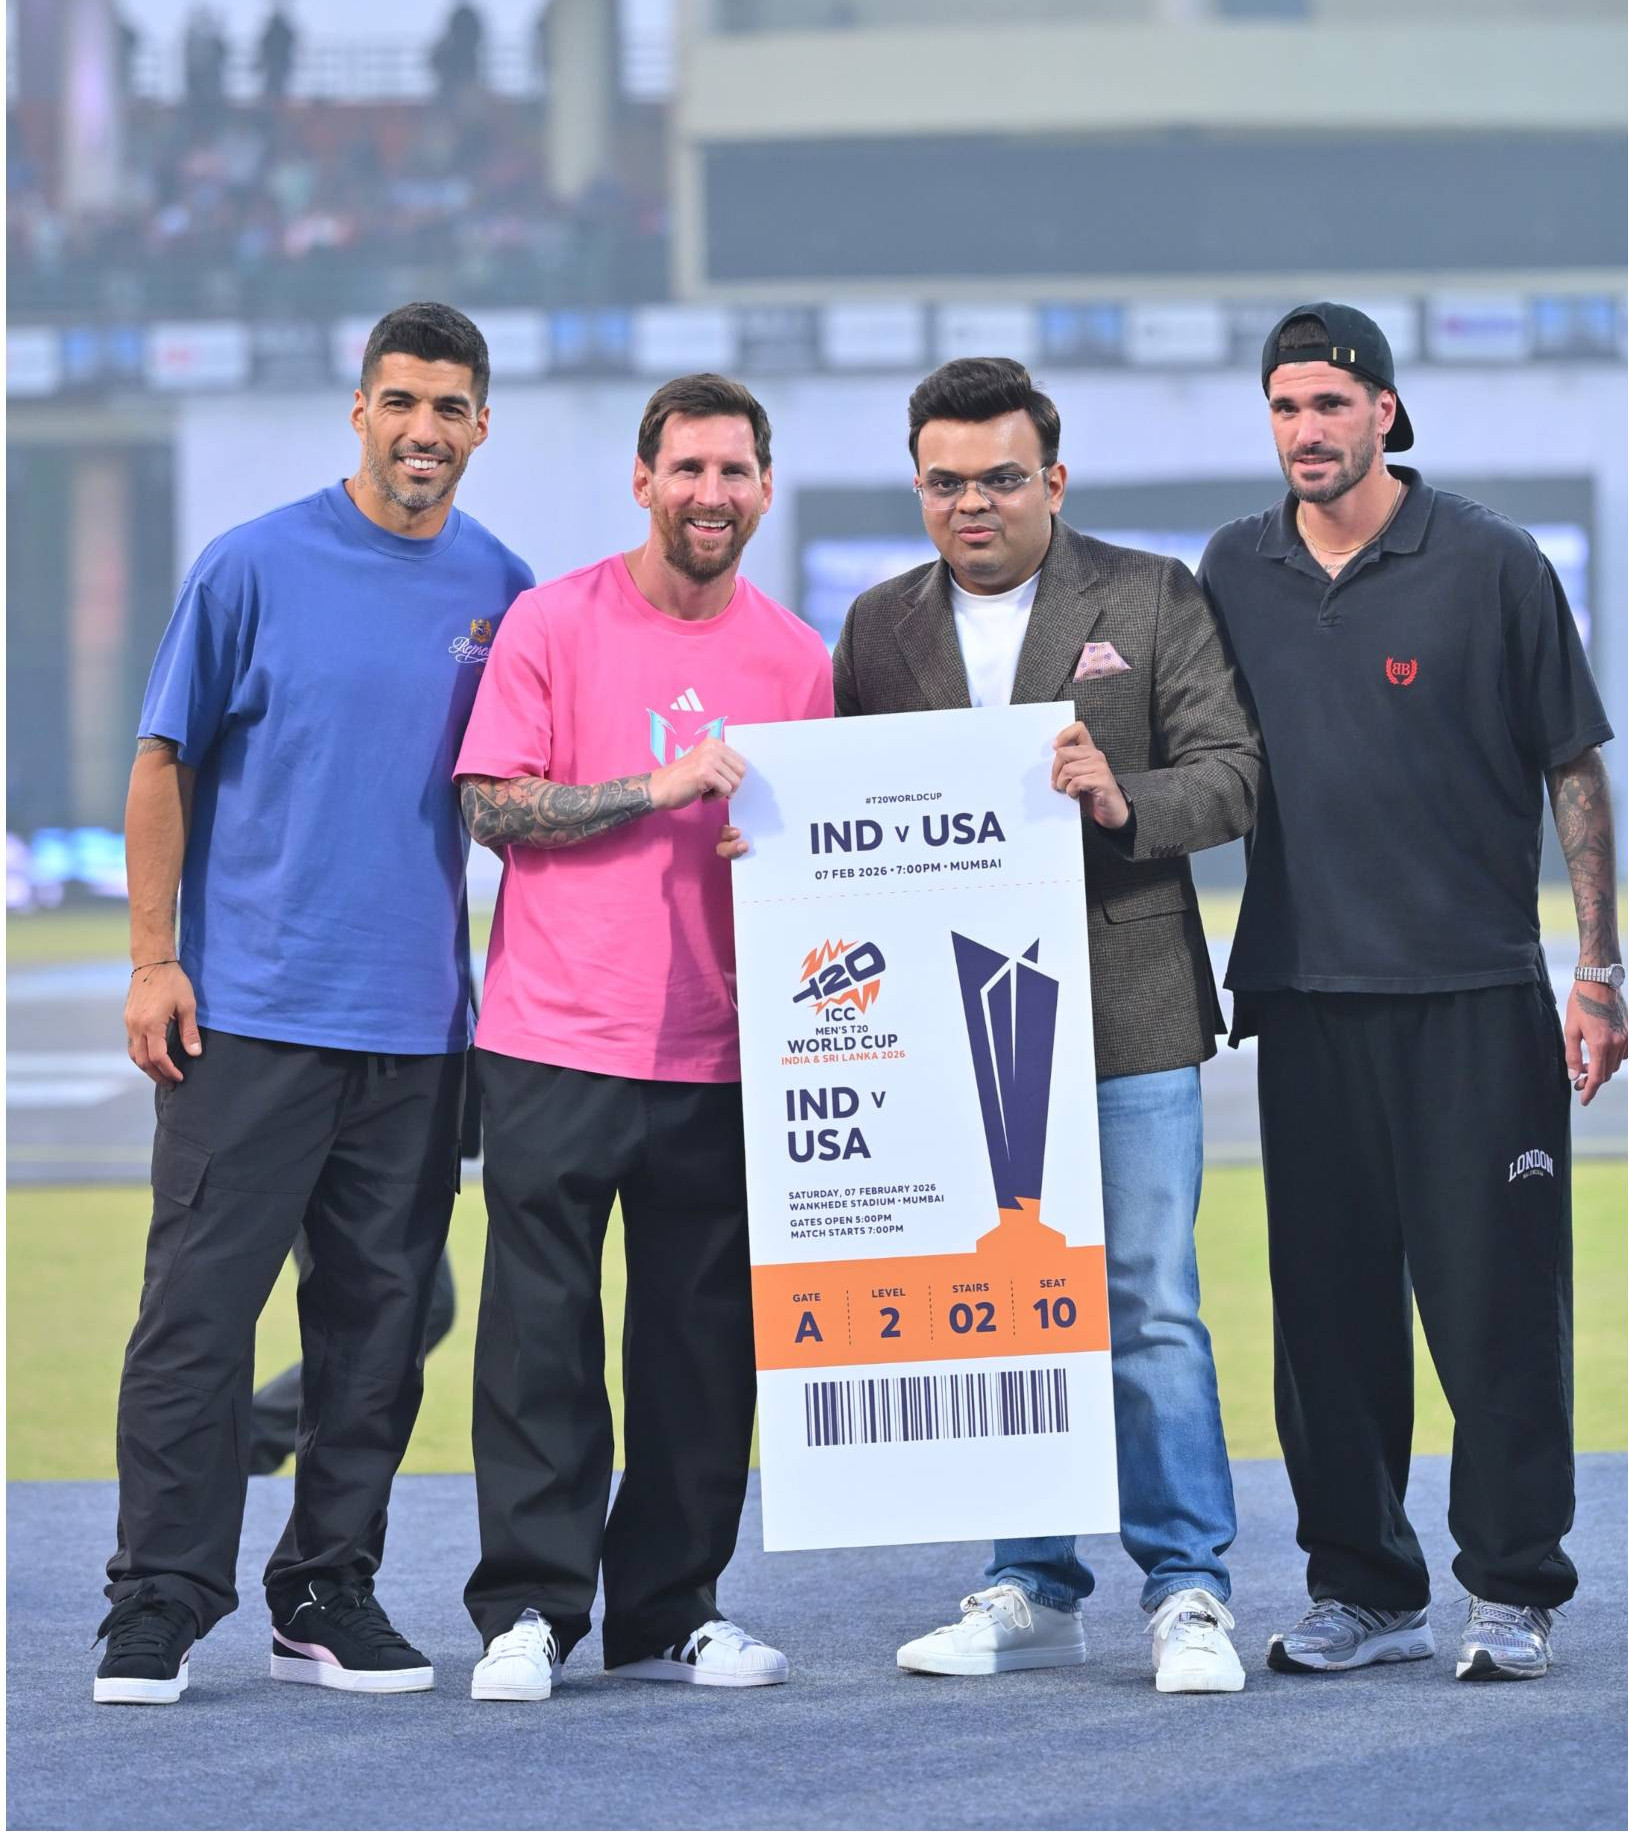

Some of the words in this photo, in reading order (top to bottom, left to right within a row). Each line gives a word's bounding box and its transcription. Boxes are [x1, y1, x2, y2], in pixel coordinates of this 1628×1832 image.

[865, 792, 943, 804] #T20WORLDCUP
[810, 819, 884, 855] IND
[894, 825, 910, 843] v
[922, 810, 1007, 847] USA
[814, 869, 829, 881] 07
[831, 868, 856, 880] FEB
[858, 866, 888, 878] 2026
[895, 862, 941, 875] 7:00PM
[949, 858, 1002, 872] MUMBAI
[792, 941, 887, 1004] T20
[825, 1006, 856, 1023] ICC
[815, 1025, 848, 1036] MEN'S
[849, 1024, 869, 1034] T20
[786, 1036, 857, 1054] WORLD
[860, 1033, 898, 1050] CUP
[781, 1055, 811, 1066] INDIA
[812, 1054, 821, 1064] &
[822, 1053, 839, 1063] SRI
[841, 1051, 879, 1062] LANKA
[881, 1049, 906, 1060] 2026
[785, 1086, 860, 1122] IND
[870, 1090, 887, 1109] v
[787, 1126, 872, 1163] USA
[1508, 1148, 1554, 1182] LONDON
[788, 1188, 842, 1200] SATURDAY,
[844, 1188, 856, 1197] 07
[859, 1184, 911, 1196] FEBRUARY
[912, 1183, 937, 1193] 2026
[789, 1199, 849, 1212] WANKHEDE
[850, 1196, 896, 1208] STADIUM
[902, 1194, 945, 1205] MUMBAI
[789, 1217, 823, 1228] GATES
[824, 1215, 853, 1226] OPEN
[855, 1213, 892, 1224] 5:00PM
[790, 1229, 826, 1239] MATCH
[828, 1226, 866, 1237] STARTS
[867, 1224, 904, 1234] 7:00PM
[952, 1282, 990, 1294] STAIRS
[1039, 1278, 1067, 1289] SEAT
[792, 1292, 821, 1303] GATE
[871, 1287, 906, 1299] LEVEL
[948, 1301, 997, 1335] 02
[1032, 1296, 1077, 1330] 10
[794, 1310, 824, 1344] A
[879, 1306, 902, 1339] 2
